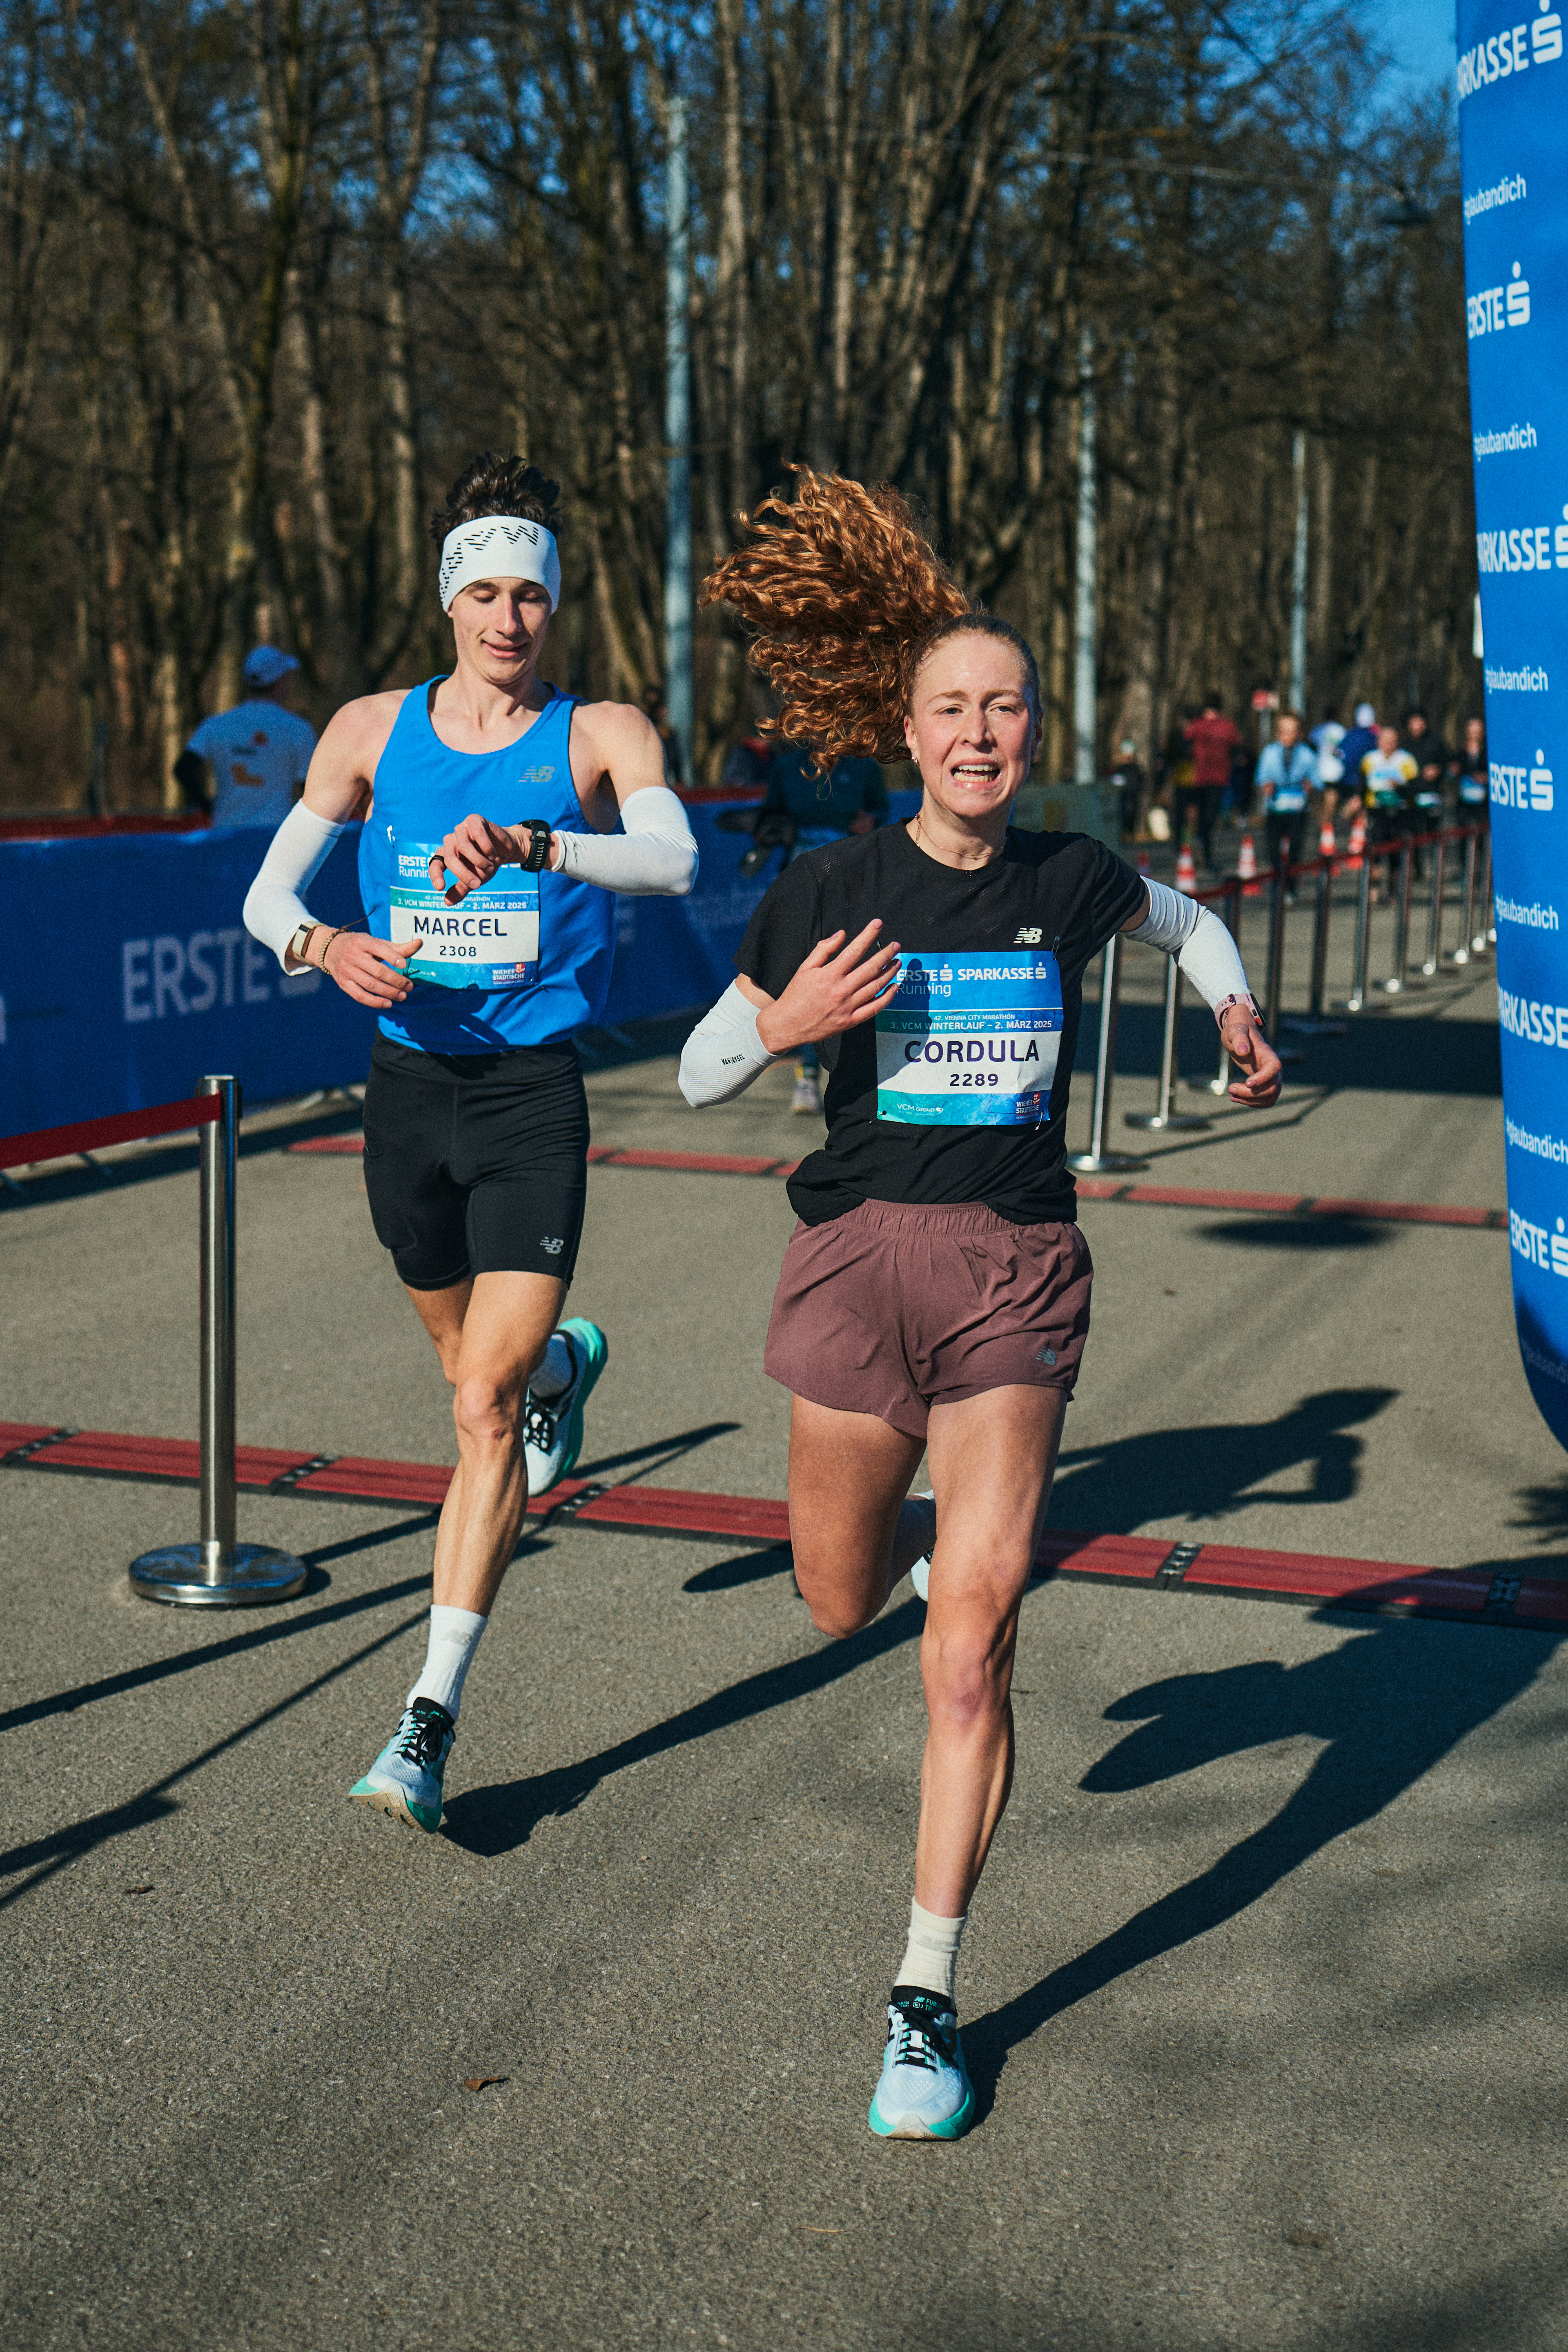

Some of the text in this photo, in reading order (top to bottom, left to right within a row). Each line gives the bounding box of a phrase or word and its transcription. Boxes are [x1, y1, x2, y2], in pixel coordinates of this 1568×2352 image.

[1467, 286, 1505, 339] ERSTE
[1490, 762, 1528, 810] ERSTE
[399, 855, 427, 867] ERSTE
[399, 866, 431, 878] Runnin
[482, 901, 506, 909] MÄRZ
[414, 916, 507, 936] MARCEL
[439, 945, 477, 957] 2308
[122, 928, 272, 1023] ERSTE
[896, 969, 938, 982] ERSTE
[958, 967, 1034, 981] SPARKASSE
[896, 982, 951, 997] Running
[925, 1021, 985, 1030] WINTERLAUF
[1006, 1019, 1031, 1029] MÄRZ
[904, 1039, 1039, 1063] CORDULA
[950, 1074, 999, 1087] 2289
[1510, 1208, 1550, 1270] ERSTE
